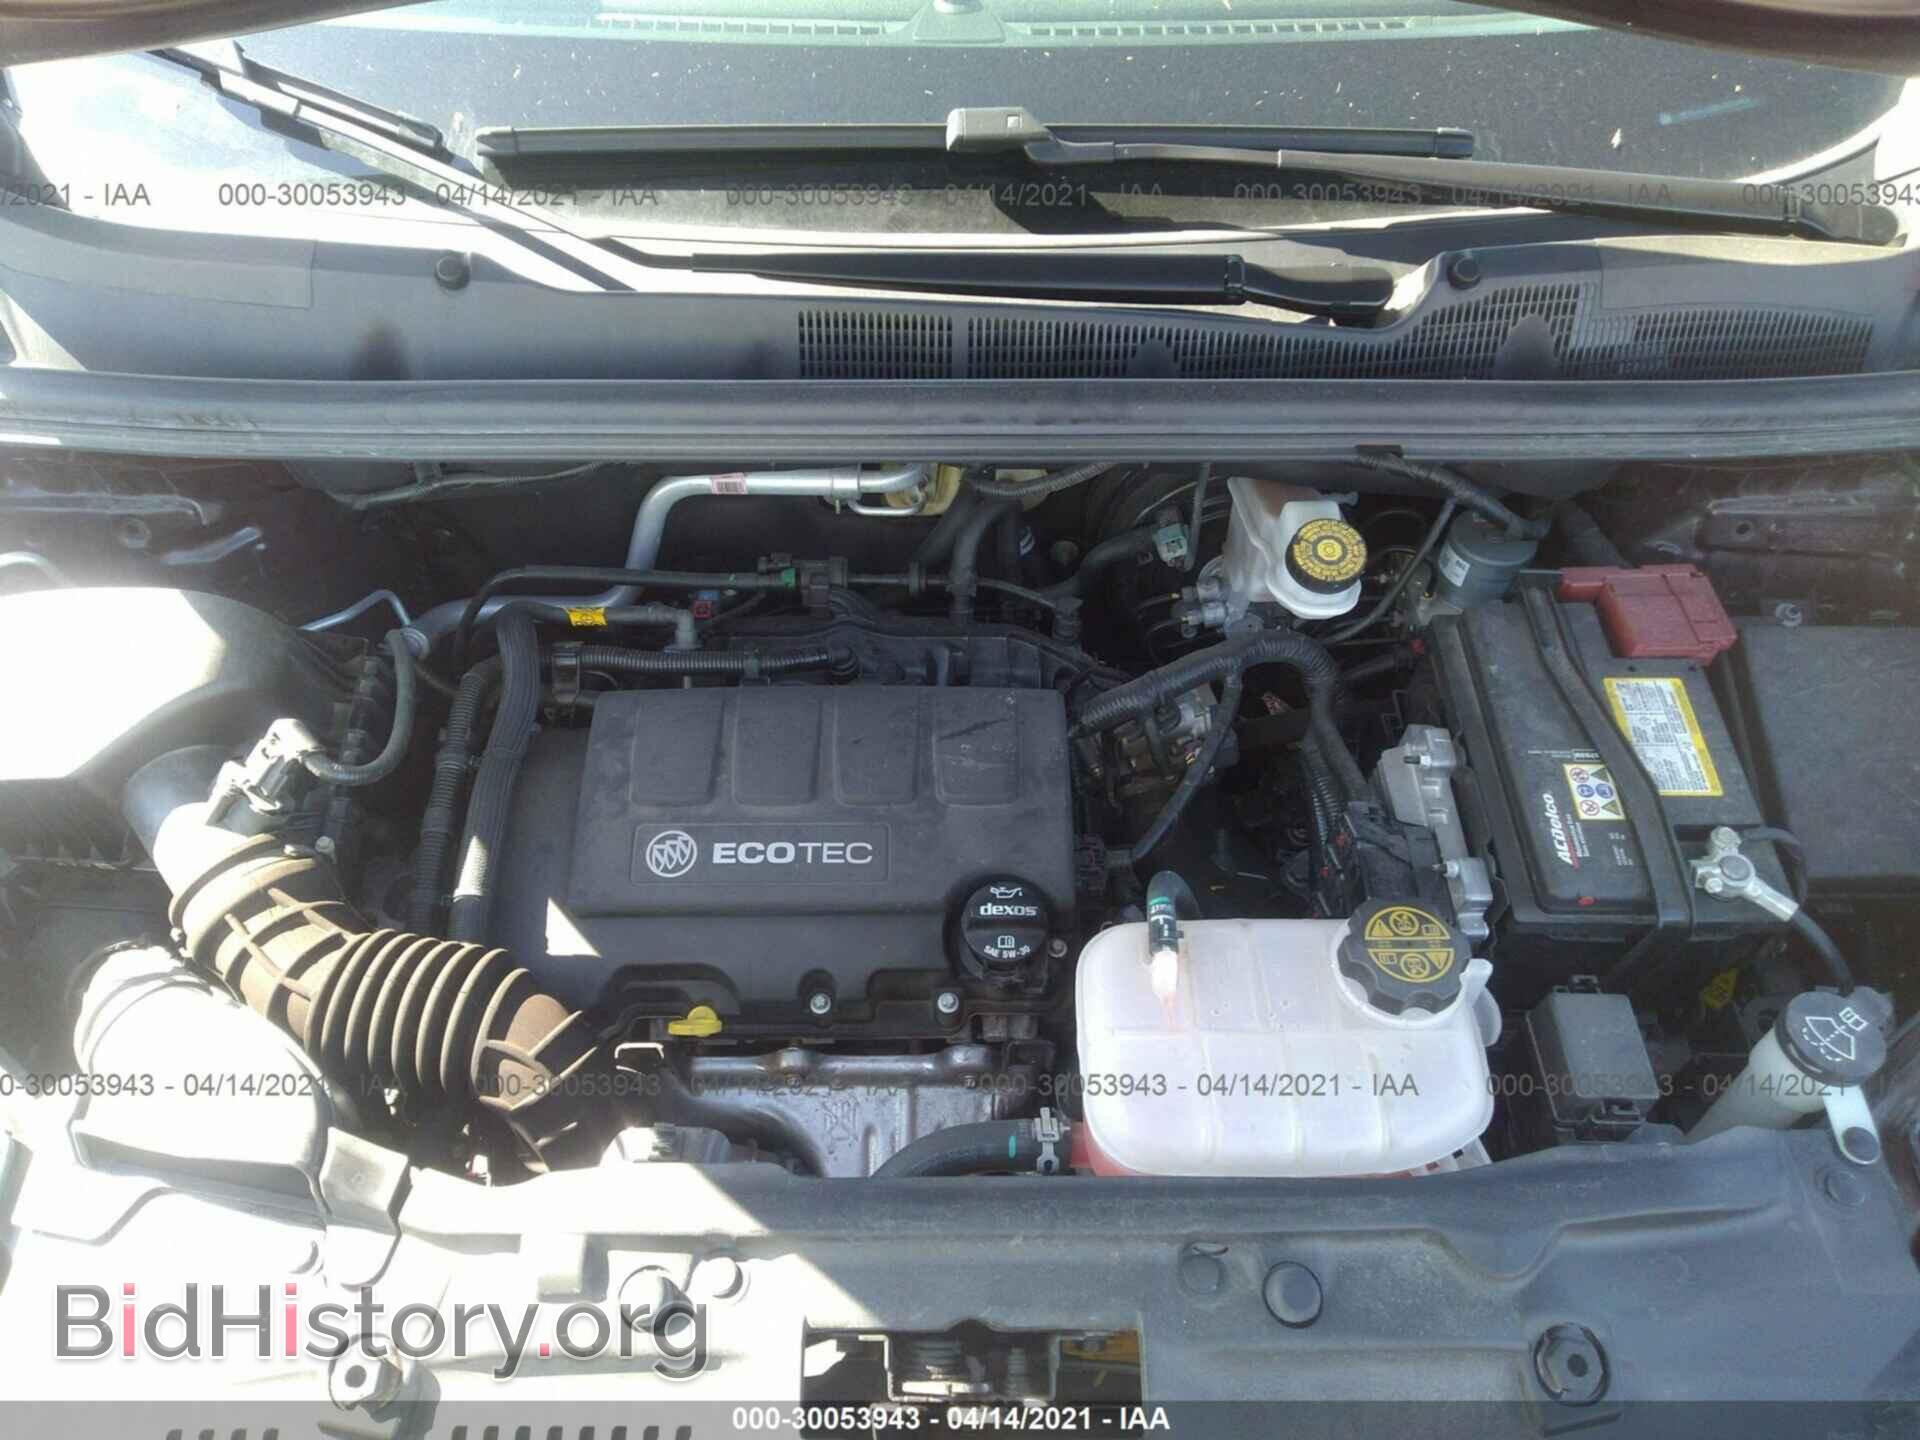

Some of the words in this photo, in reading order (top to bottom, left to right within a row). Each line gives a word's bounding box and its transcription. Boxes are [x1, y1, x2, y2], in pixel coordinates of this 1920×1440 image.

[1542, 792, 1573, 865] ACDelco
[712, 842, 873, 864] ECOTEC
[979, 902, 1038, 916] dexos
